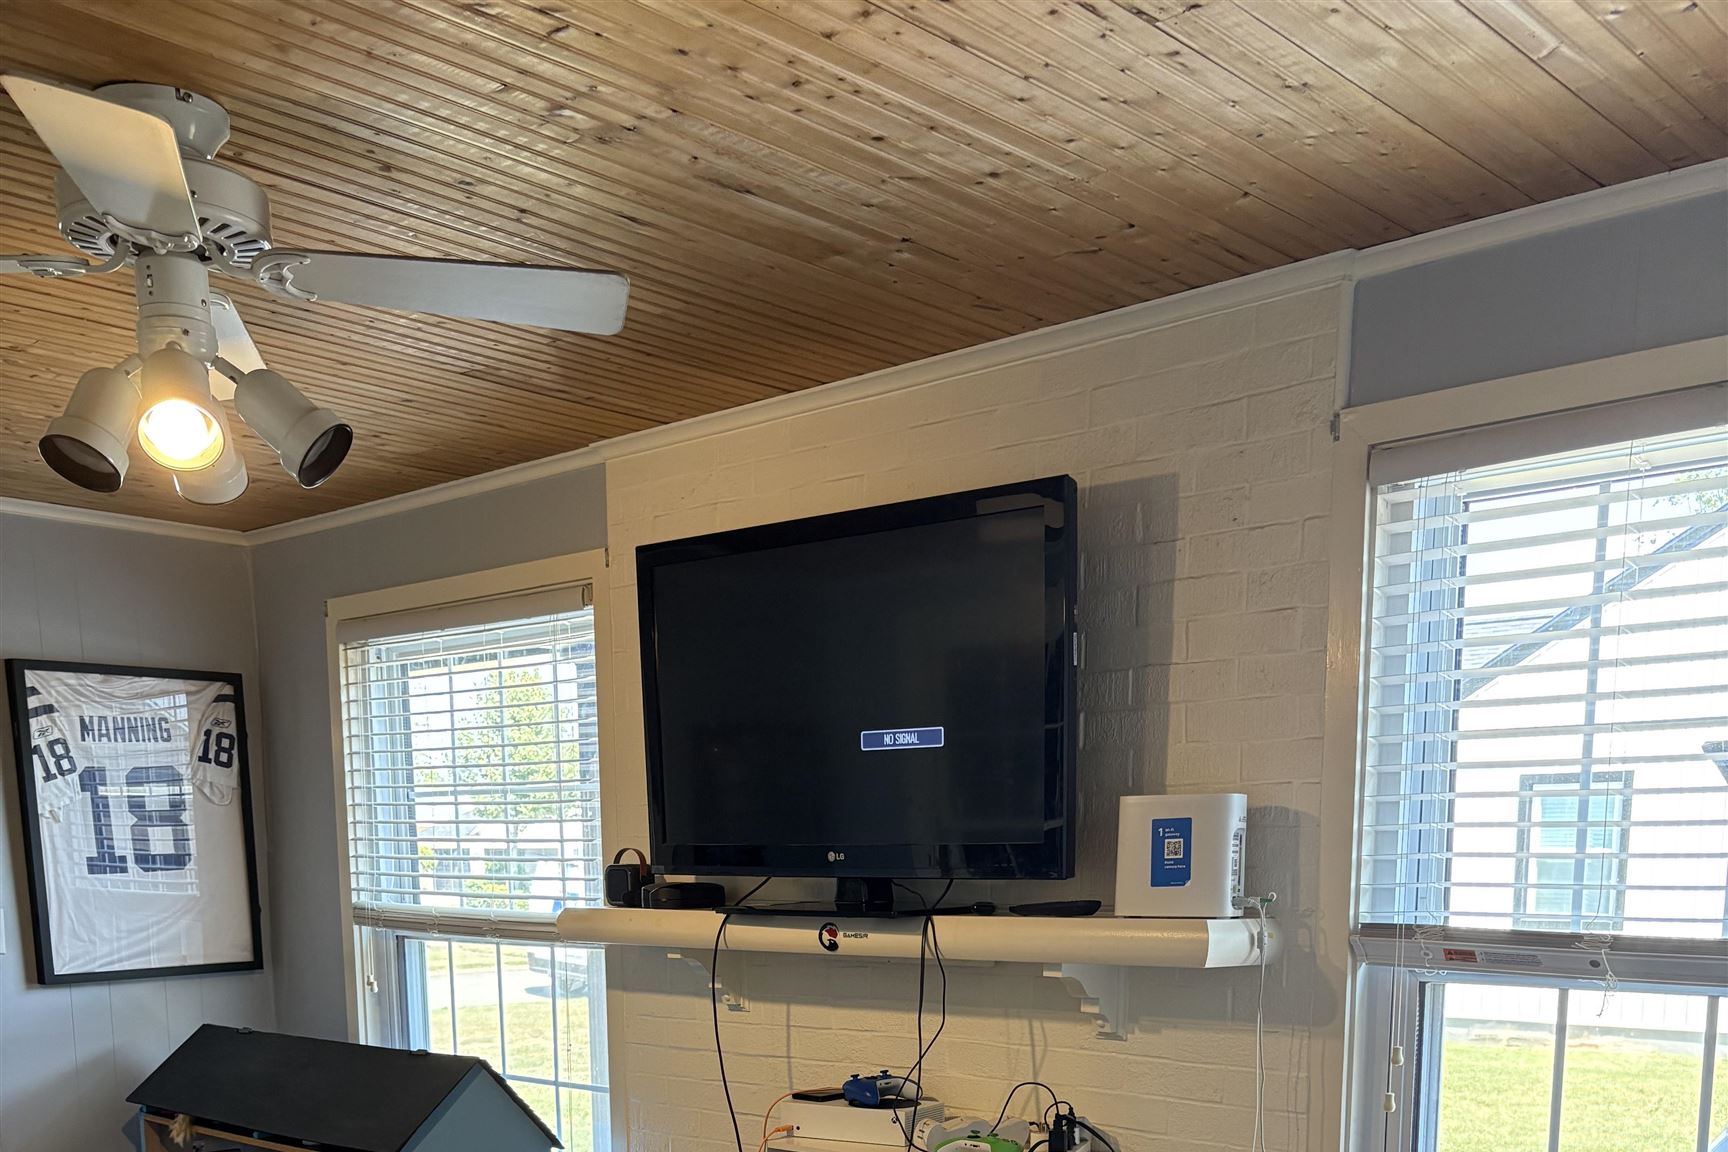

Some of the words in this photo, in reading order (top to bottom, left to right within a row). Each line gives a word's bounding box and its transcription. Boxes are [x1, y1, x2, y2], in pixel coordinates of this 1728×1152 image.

[79, 715, 172, 743] MANNING
[198, 728, 236, 769] 18
[884, 733, 894, 745] NO
[895, 732, 920, 744] SIGNAL
[32, 737, 77, 783] 18
[78, 765, 192, 875] 18
